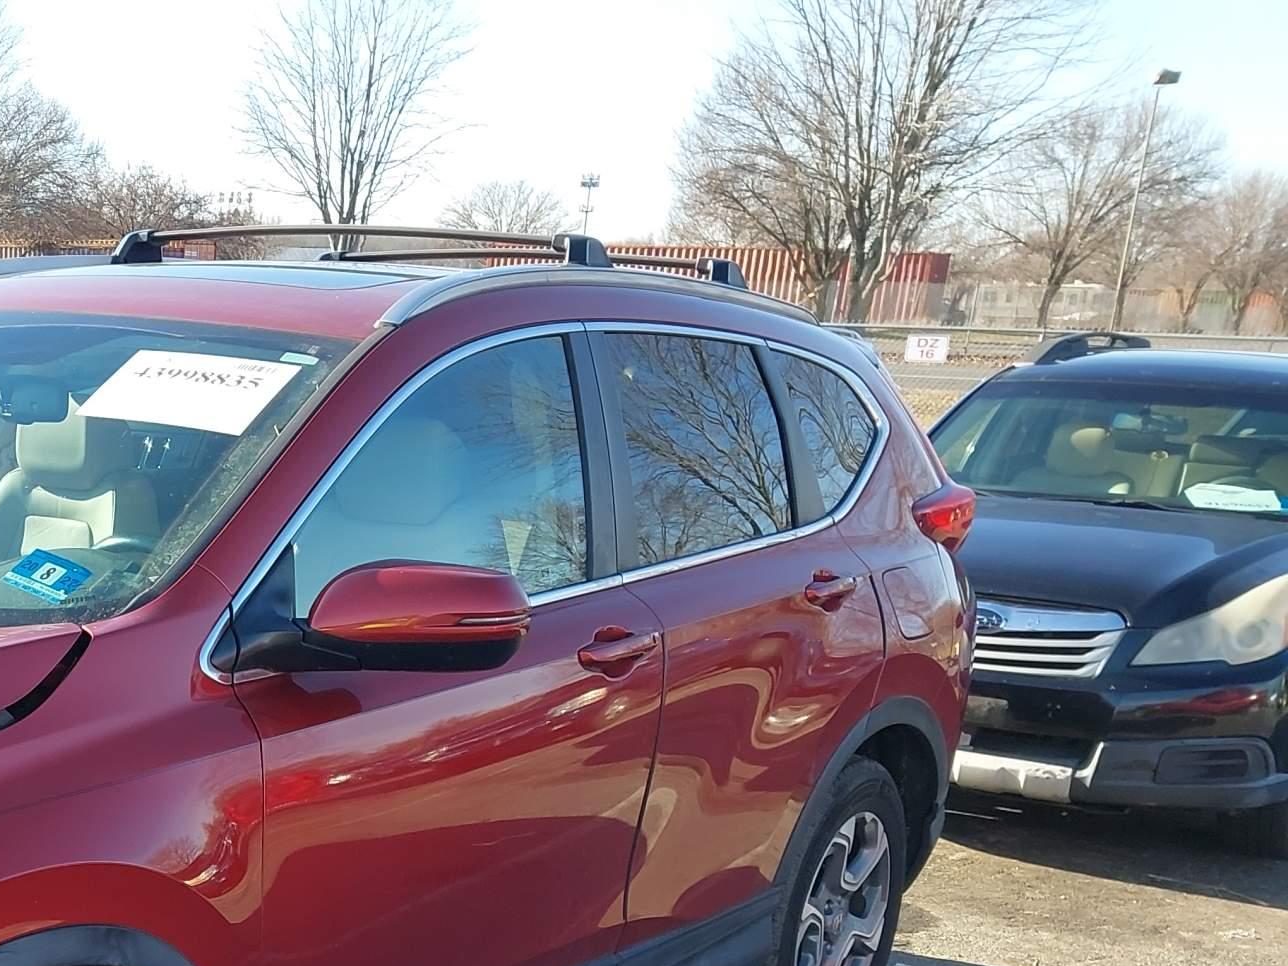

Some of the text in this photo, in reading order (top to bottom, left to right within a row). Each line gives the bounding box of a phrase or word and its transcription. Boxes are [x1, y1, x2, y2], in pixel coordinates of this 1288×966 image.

[917, 338, 940, 348] DZ
[919, 349, 935, 359] 16
[39, 567, 57, 580] 8
